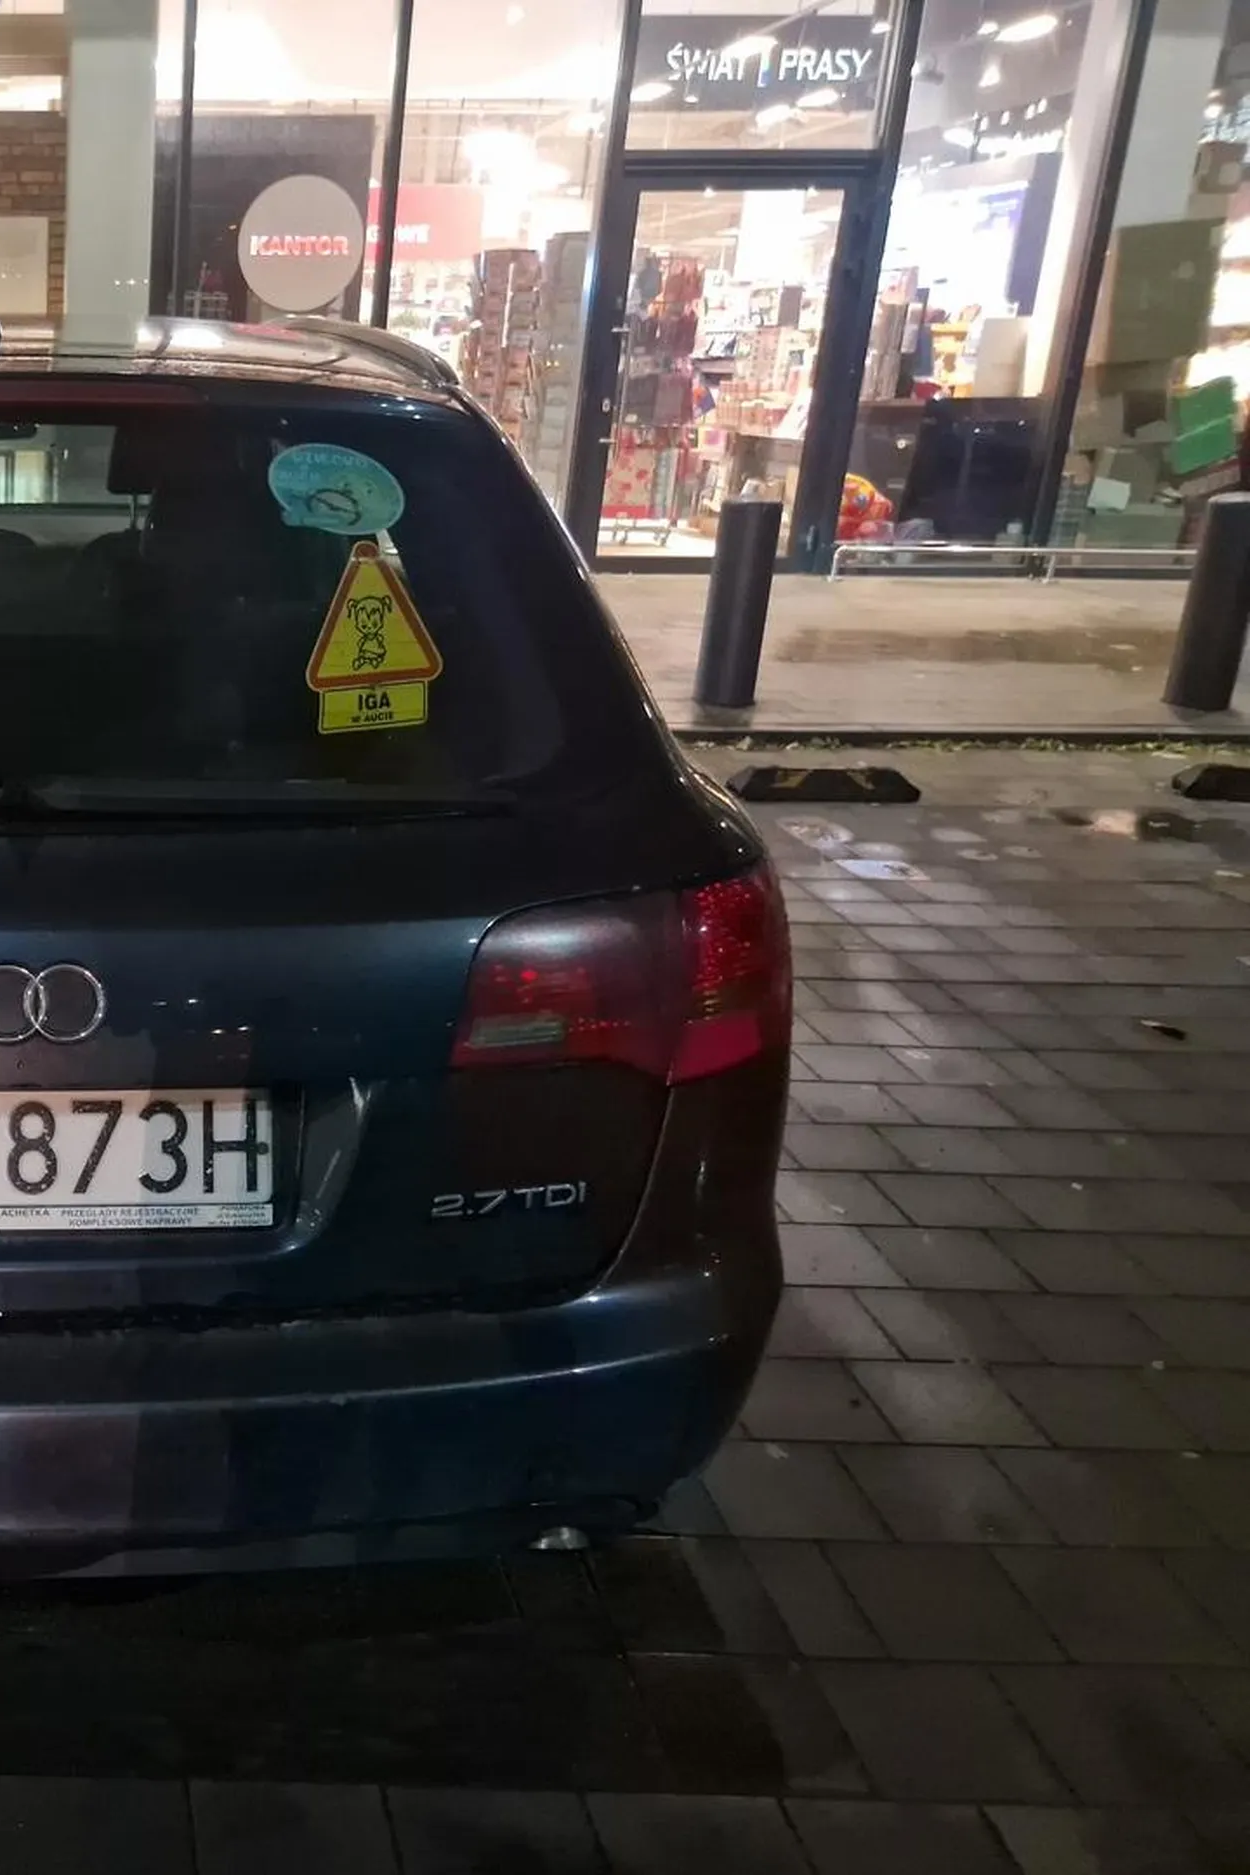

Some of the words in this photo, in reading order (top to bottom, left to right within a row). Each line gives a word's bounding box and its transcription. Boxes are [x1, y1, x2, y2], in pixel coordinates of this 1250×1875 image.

[666, 42, 750, 81] ŚWIAT
[778, 49, 872, 81] PRASY
[249, 235, 349, 256] KANTOR
[358, 691, 391, 711] IGA
[363, 711, 393, 722] AUCIE
[431, 1188, 507, 1217] 2.7
[514, 1180, 587, 1209] TDI
